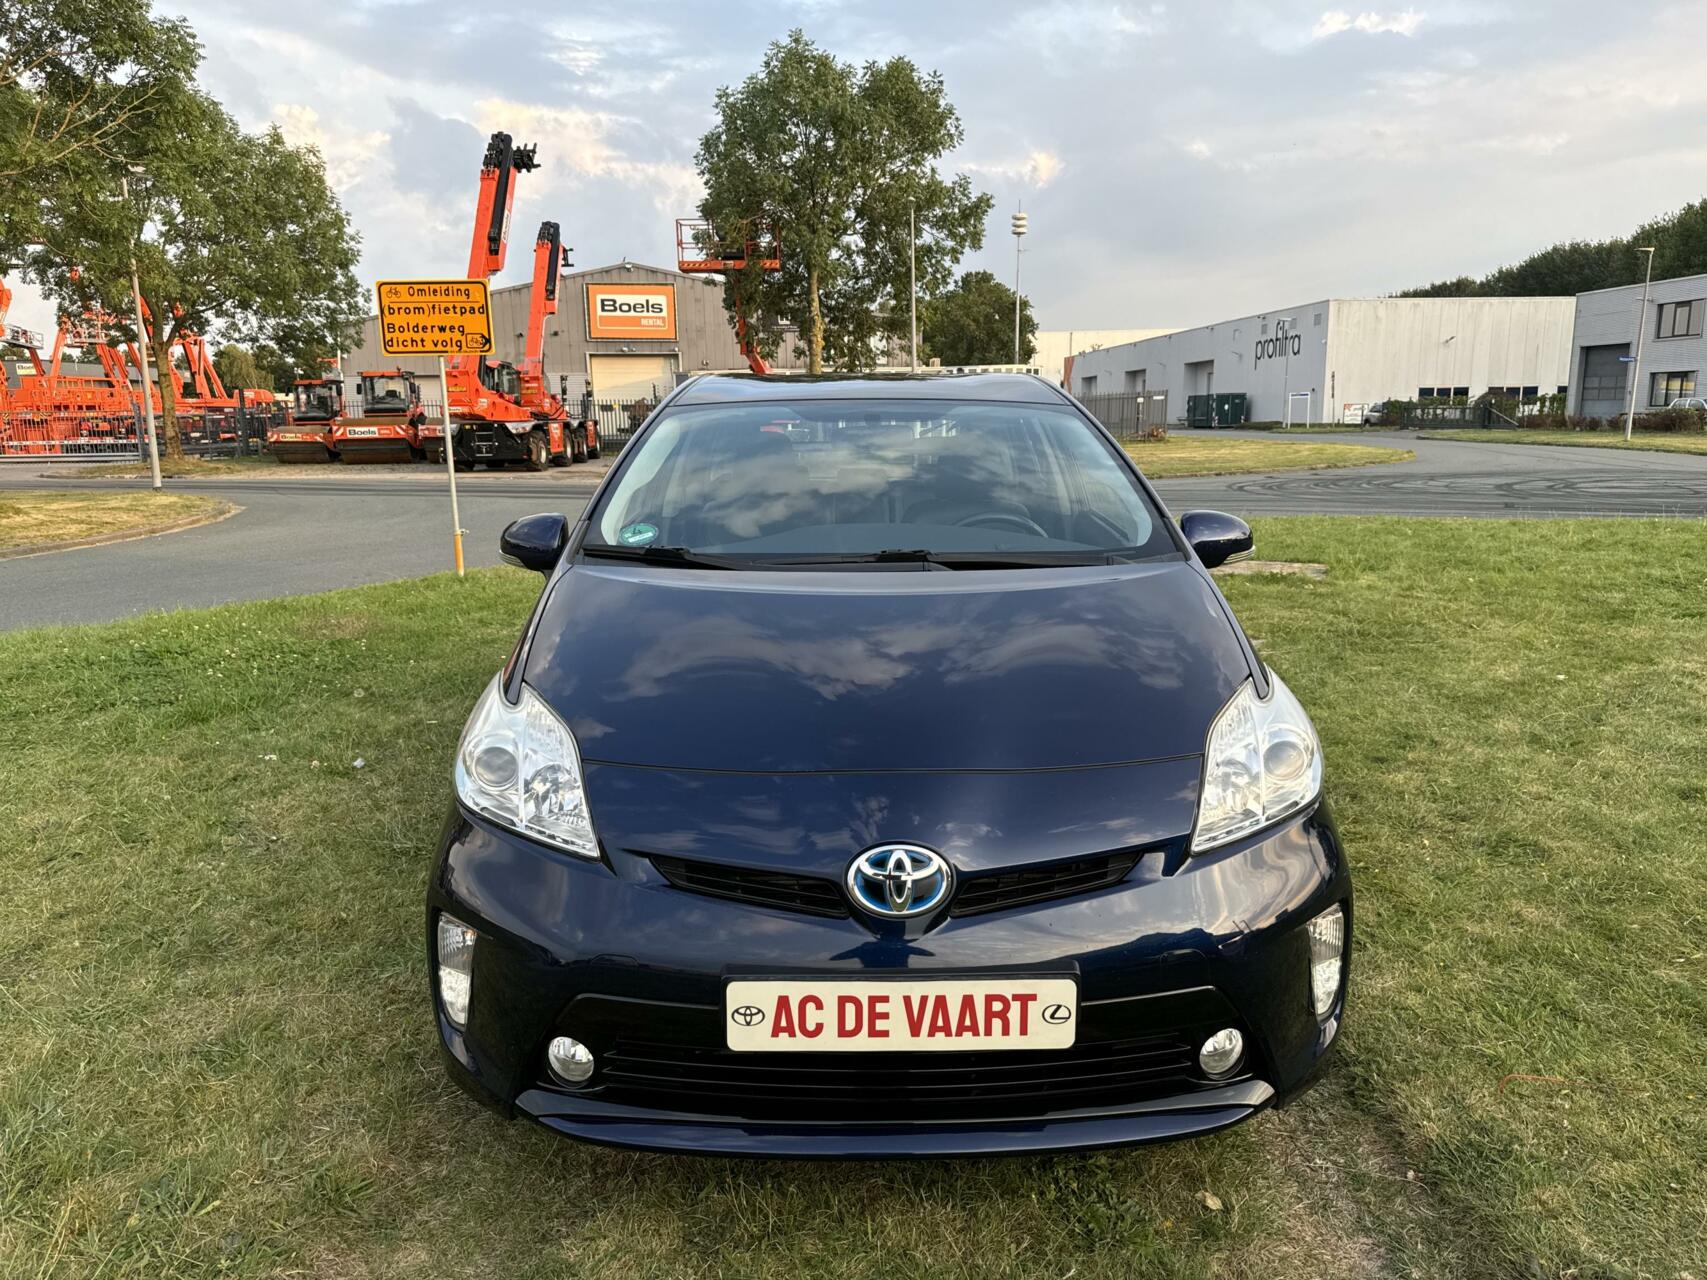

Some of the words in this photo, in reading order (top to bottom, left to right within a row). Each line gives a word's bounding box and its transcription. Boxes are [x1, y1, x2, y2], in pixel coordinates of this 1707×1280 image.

[407, 286, 470, 299] Omleiding
[382, 304, 485, 317] (brom)fietpad
[600, 298, 663, 313] Boels
[386, 322, 465, 336] Bolderweg
[640, 318, 665, 326] RENTAL
[386, 337, 426, 348] dicht
[432, 337, 463, 351] volg
[1254, 319, 1301, 370] profiltra
[770, 995, 825, 1039] AC
[837, 994, 890, 1038] DE
[902, 993, 1038, 1038] VAART
